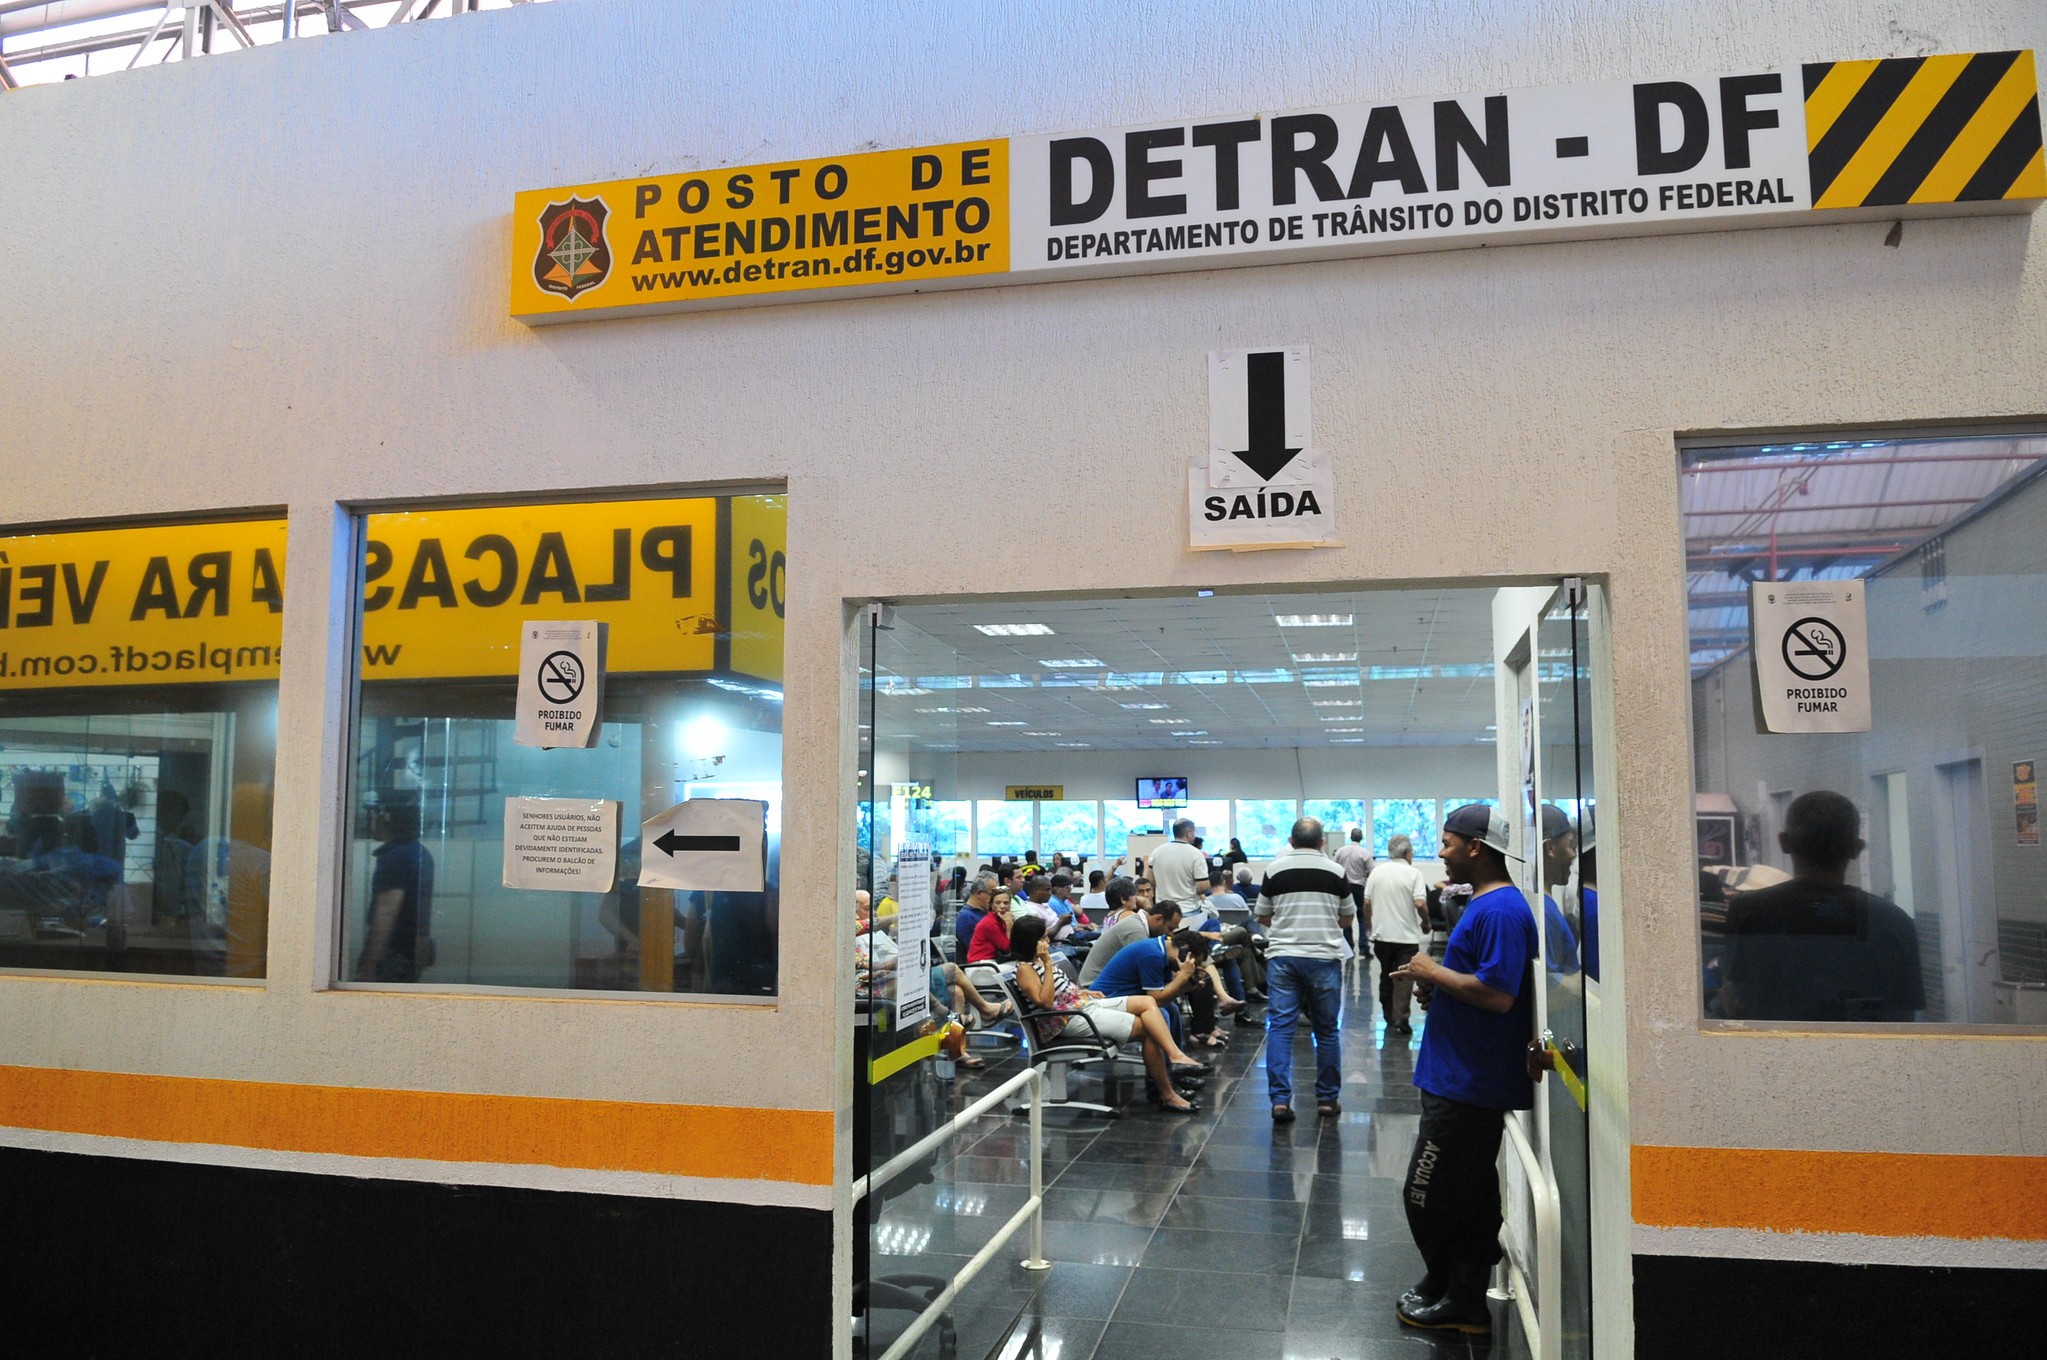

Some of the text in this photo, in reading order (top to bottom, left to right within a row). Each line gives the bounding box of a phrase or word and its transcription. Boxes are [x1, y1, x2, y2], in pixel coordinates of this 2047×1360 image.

[1049, 73, 1782, 226] DETRAN - DF
[635, 148, 991, 219] POSTO DE
[1046, 178, 1794, 261] DEPARTAMENTO DE TRÂNSITO DO DISTRITO FEDERAL
[630, 196, 991, 266] ATENDIMENTO
[630, 240, 992, 293] www.detran.df.gov.br
[1204, 487, 1322, 522] SAÍDA
[1786, 687, 1847, 700] PROIBIDO
[1797, 702, 1838, 713] FUMAR
[538, 710, 582, 720] PROIBIDO
[545, 721, 574, 731] FUMAR
[1015, 786, 1054, 799] VEÍCULOS
[522, 812, 601, 822] SENHORES USUÁRIOS, NÃO
[547, 834, 560, 842] NÃO
[515, 844, 557, 852] DEVIDAMENTE
[522, 855, 555, 863] PROCUREM
[563, 856, 586, 864] BALCÃO
[1410, 1140, 1441, 1208] ACQUA JET
